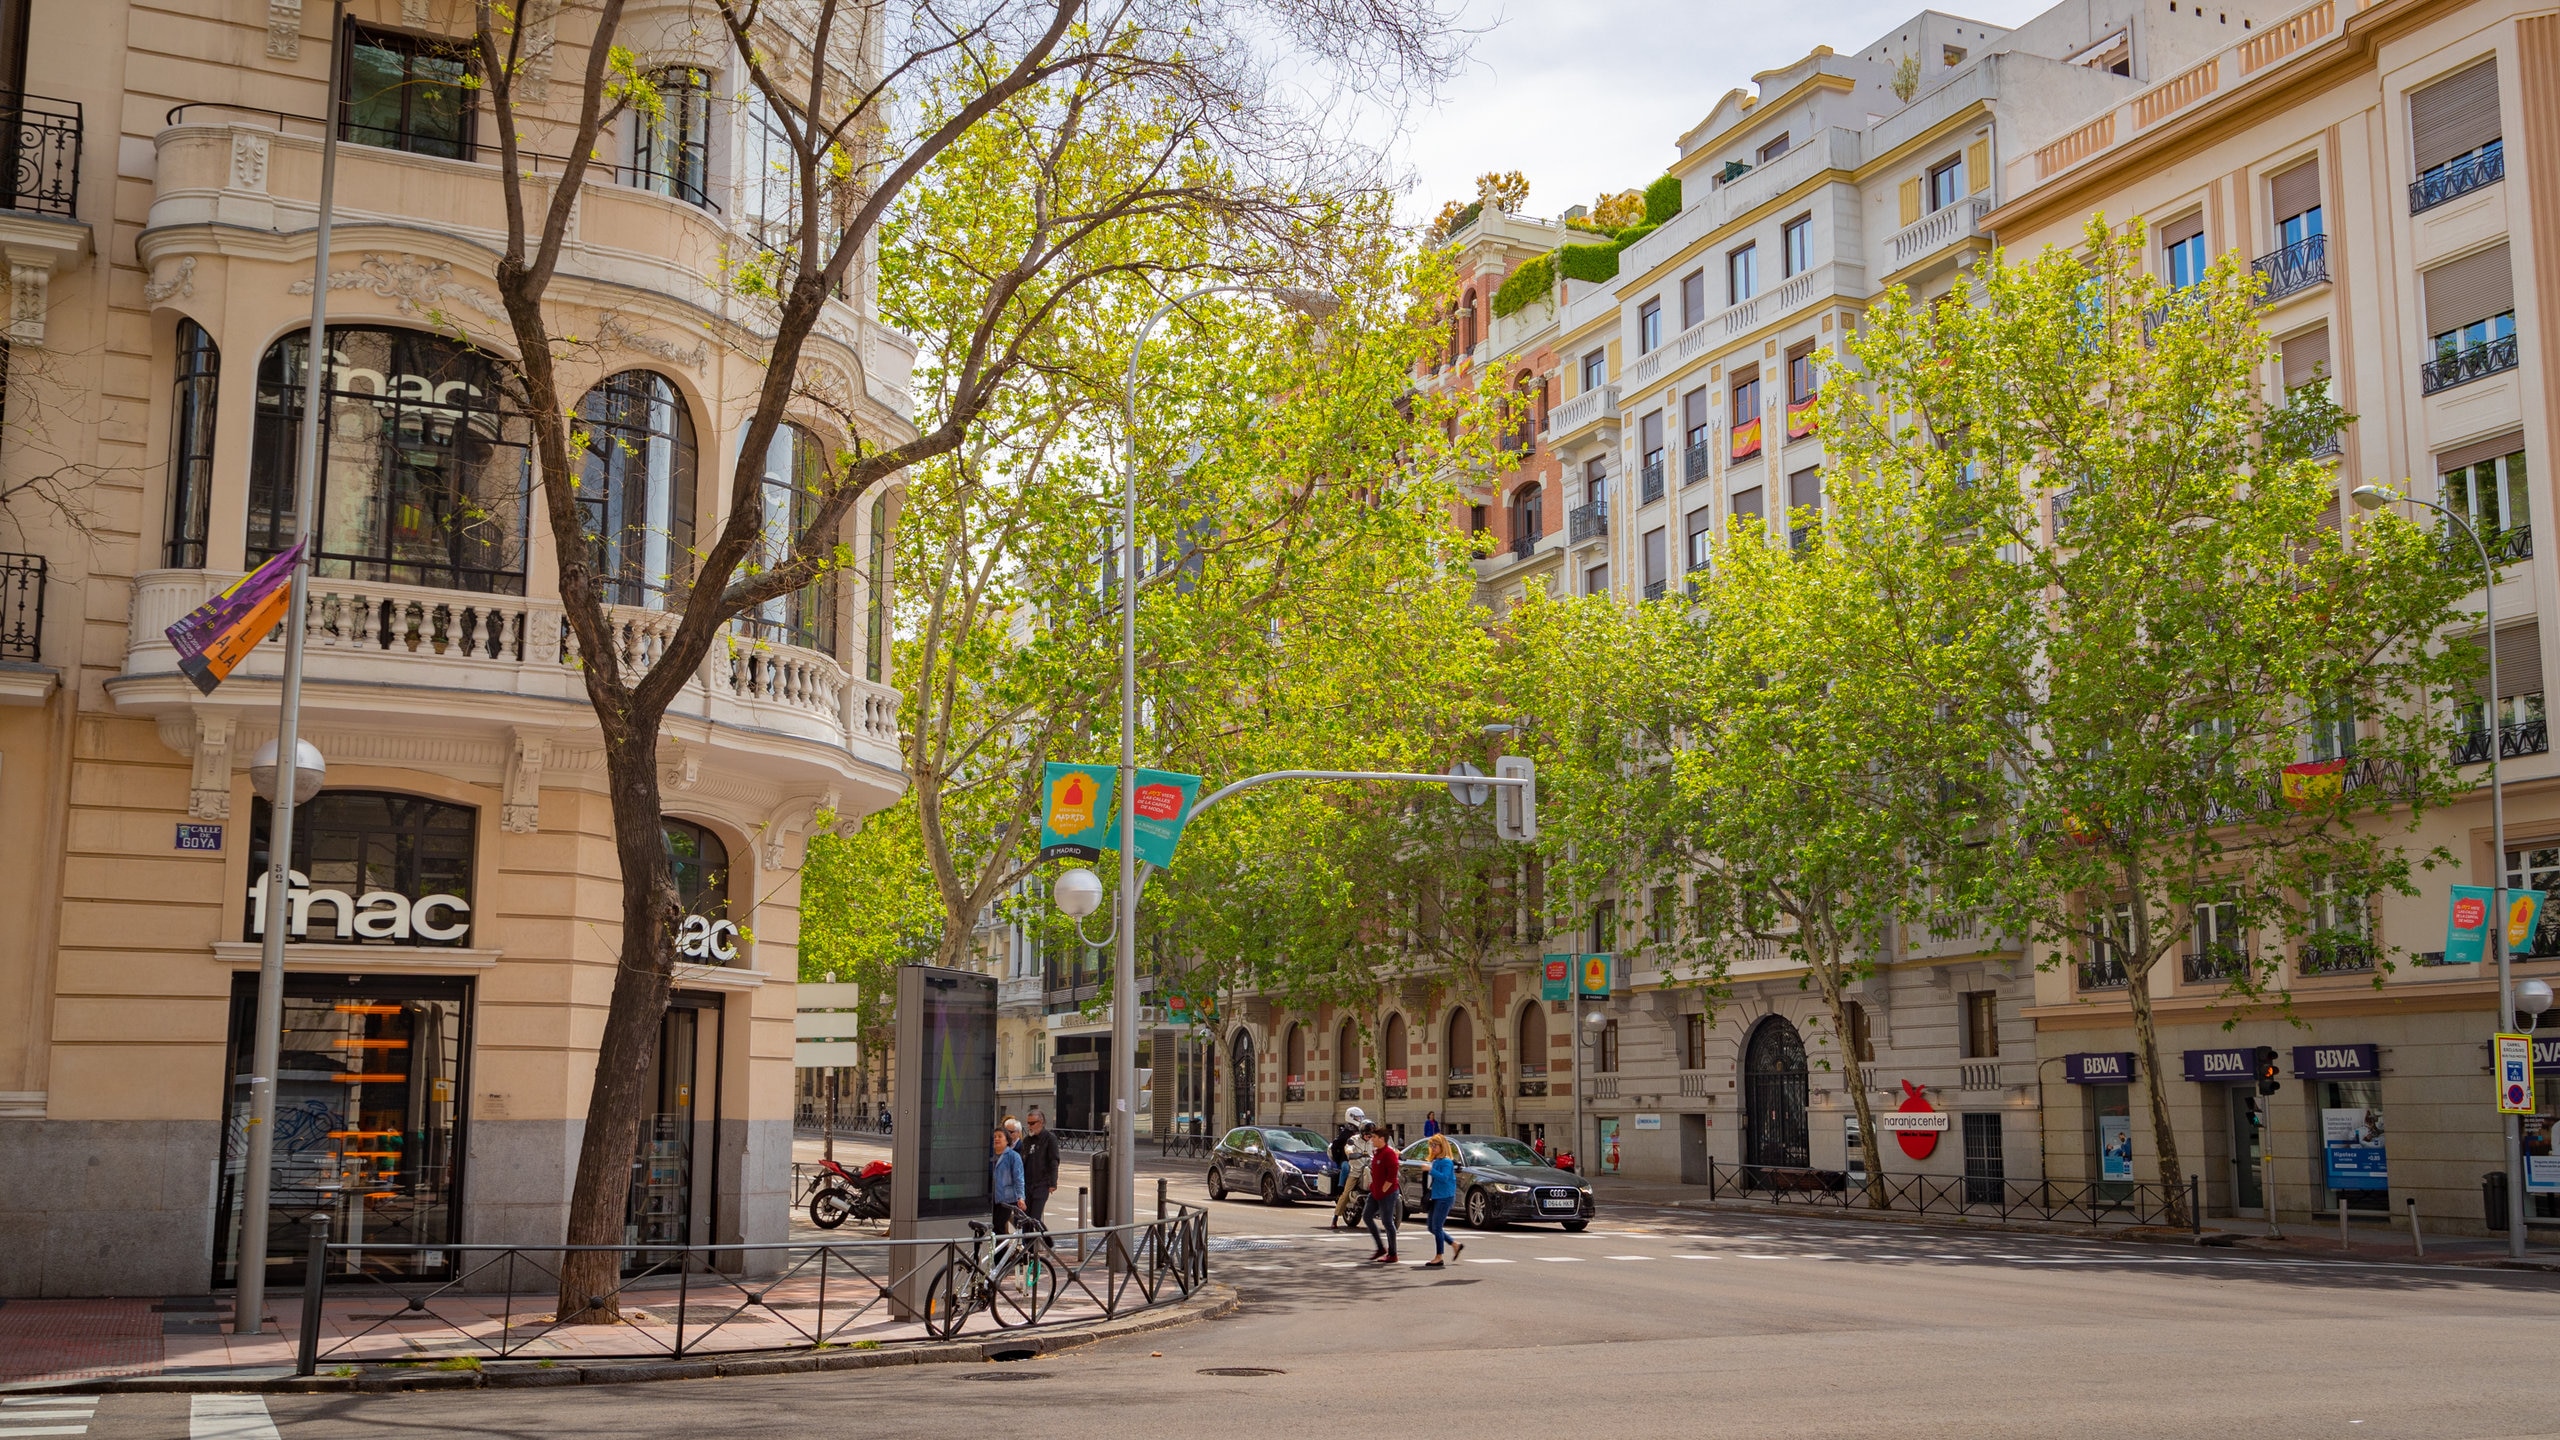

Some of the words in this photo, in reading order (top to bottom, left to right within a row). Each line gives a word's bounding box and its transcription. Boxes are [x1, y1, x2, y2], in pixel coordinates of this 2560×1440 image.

[301, 348, 482, 418] fnac
[1151, 801, 1172, 811] CAPITAL
[1152, 796, 1171, 804] CALLES
[1147, 806, 1164, 814] MODA
[1055, 813, 1086, 823] MADRID
[190, 826, 221, 834] CALLE
[182, 837, 216, 849] GOYA
[1056, 847, 1082, 855] MADRID
[248, 869, 471, 941] fnac
[675, 914, 739, 961] ac
[2315, 1049, 2360, 1069] BBVA
[2532, 1042, 2560, 1063] BVA
[2083, 1057, 2119, 1075] BBVA
[2203, 1053, 2244, 1072] BBVA
[1884, 1115, 1917, 1128] naranja
[1917, 1115, 1947, 1127] center
